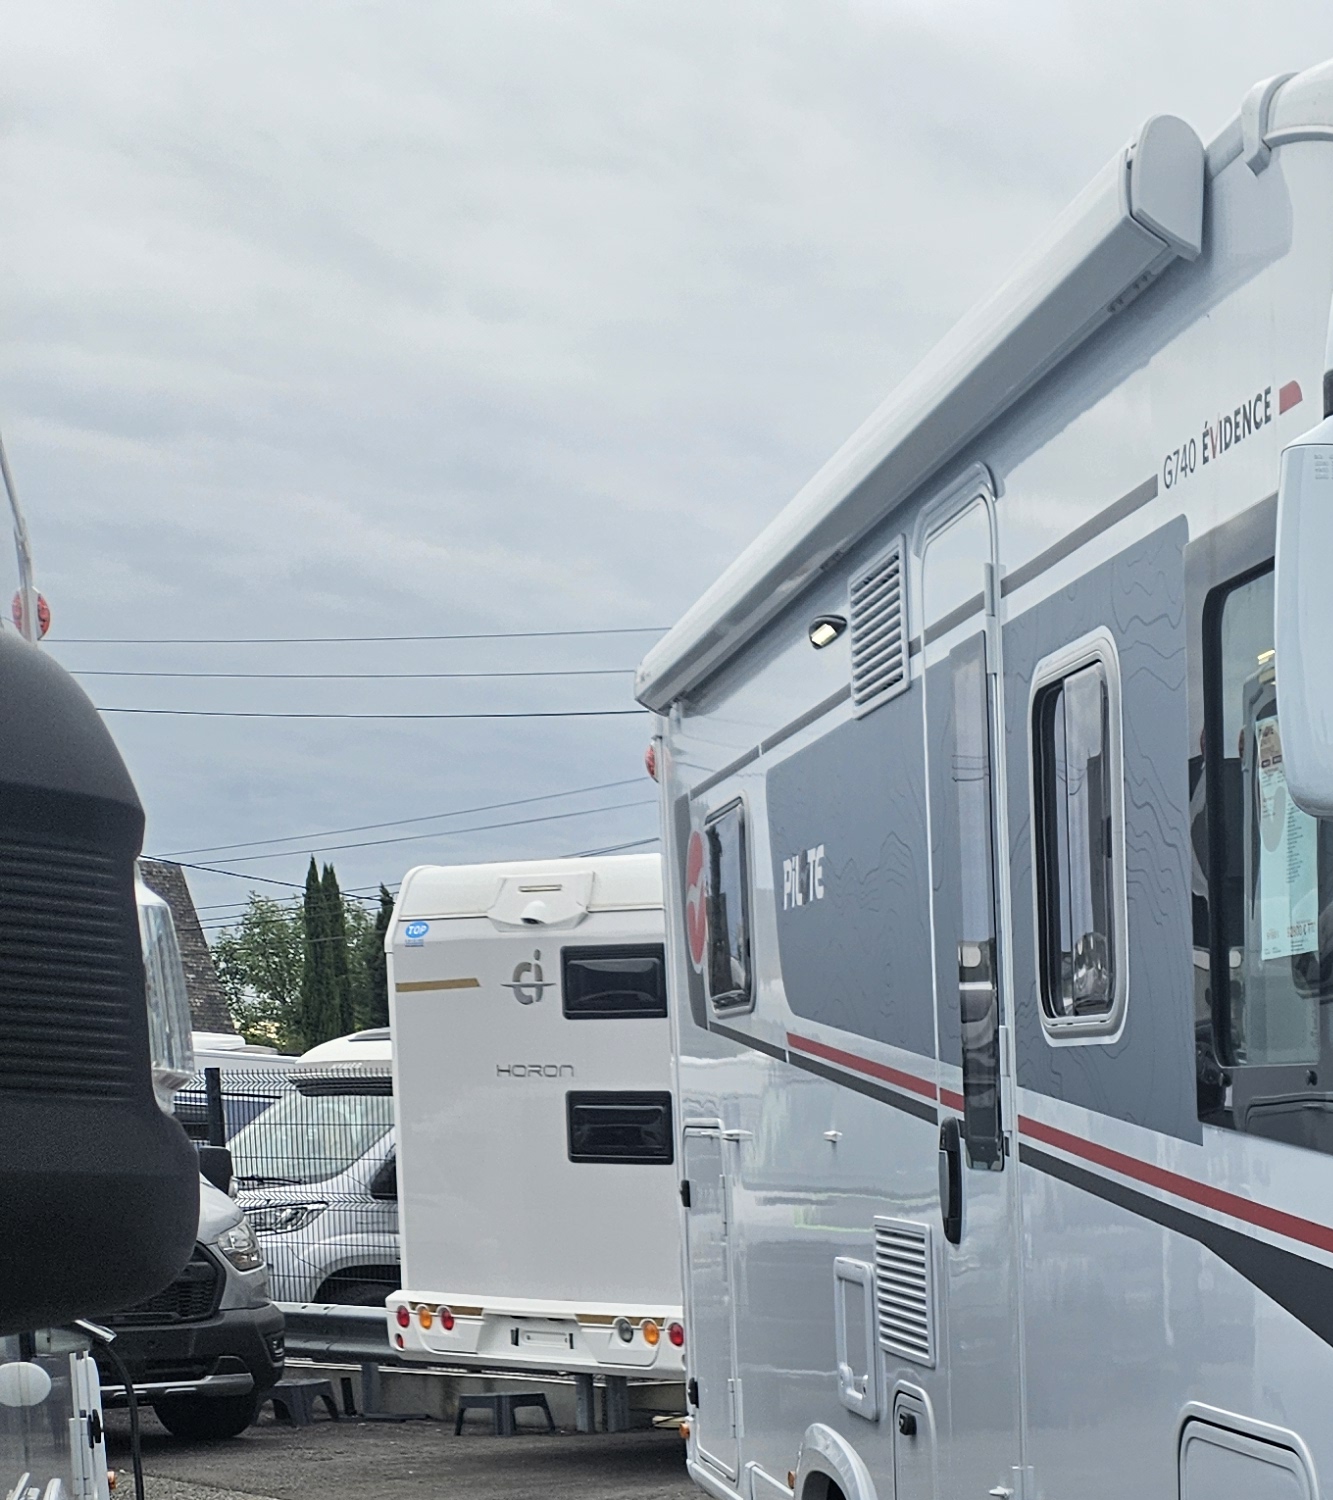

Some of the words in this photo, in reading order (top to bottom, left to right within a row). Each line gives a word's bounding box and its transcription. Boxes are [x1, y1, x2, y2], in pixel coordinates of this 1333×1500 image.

[1163, 437, 1197, 490] G740
[1202, 386, 1272, 466] ÉVIDENCE
[408, 925, 427, 935] TOP
[496, 1064, 575, 1078] HORON
